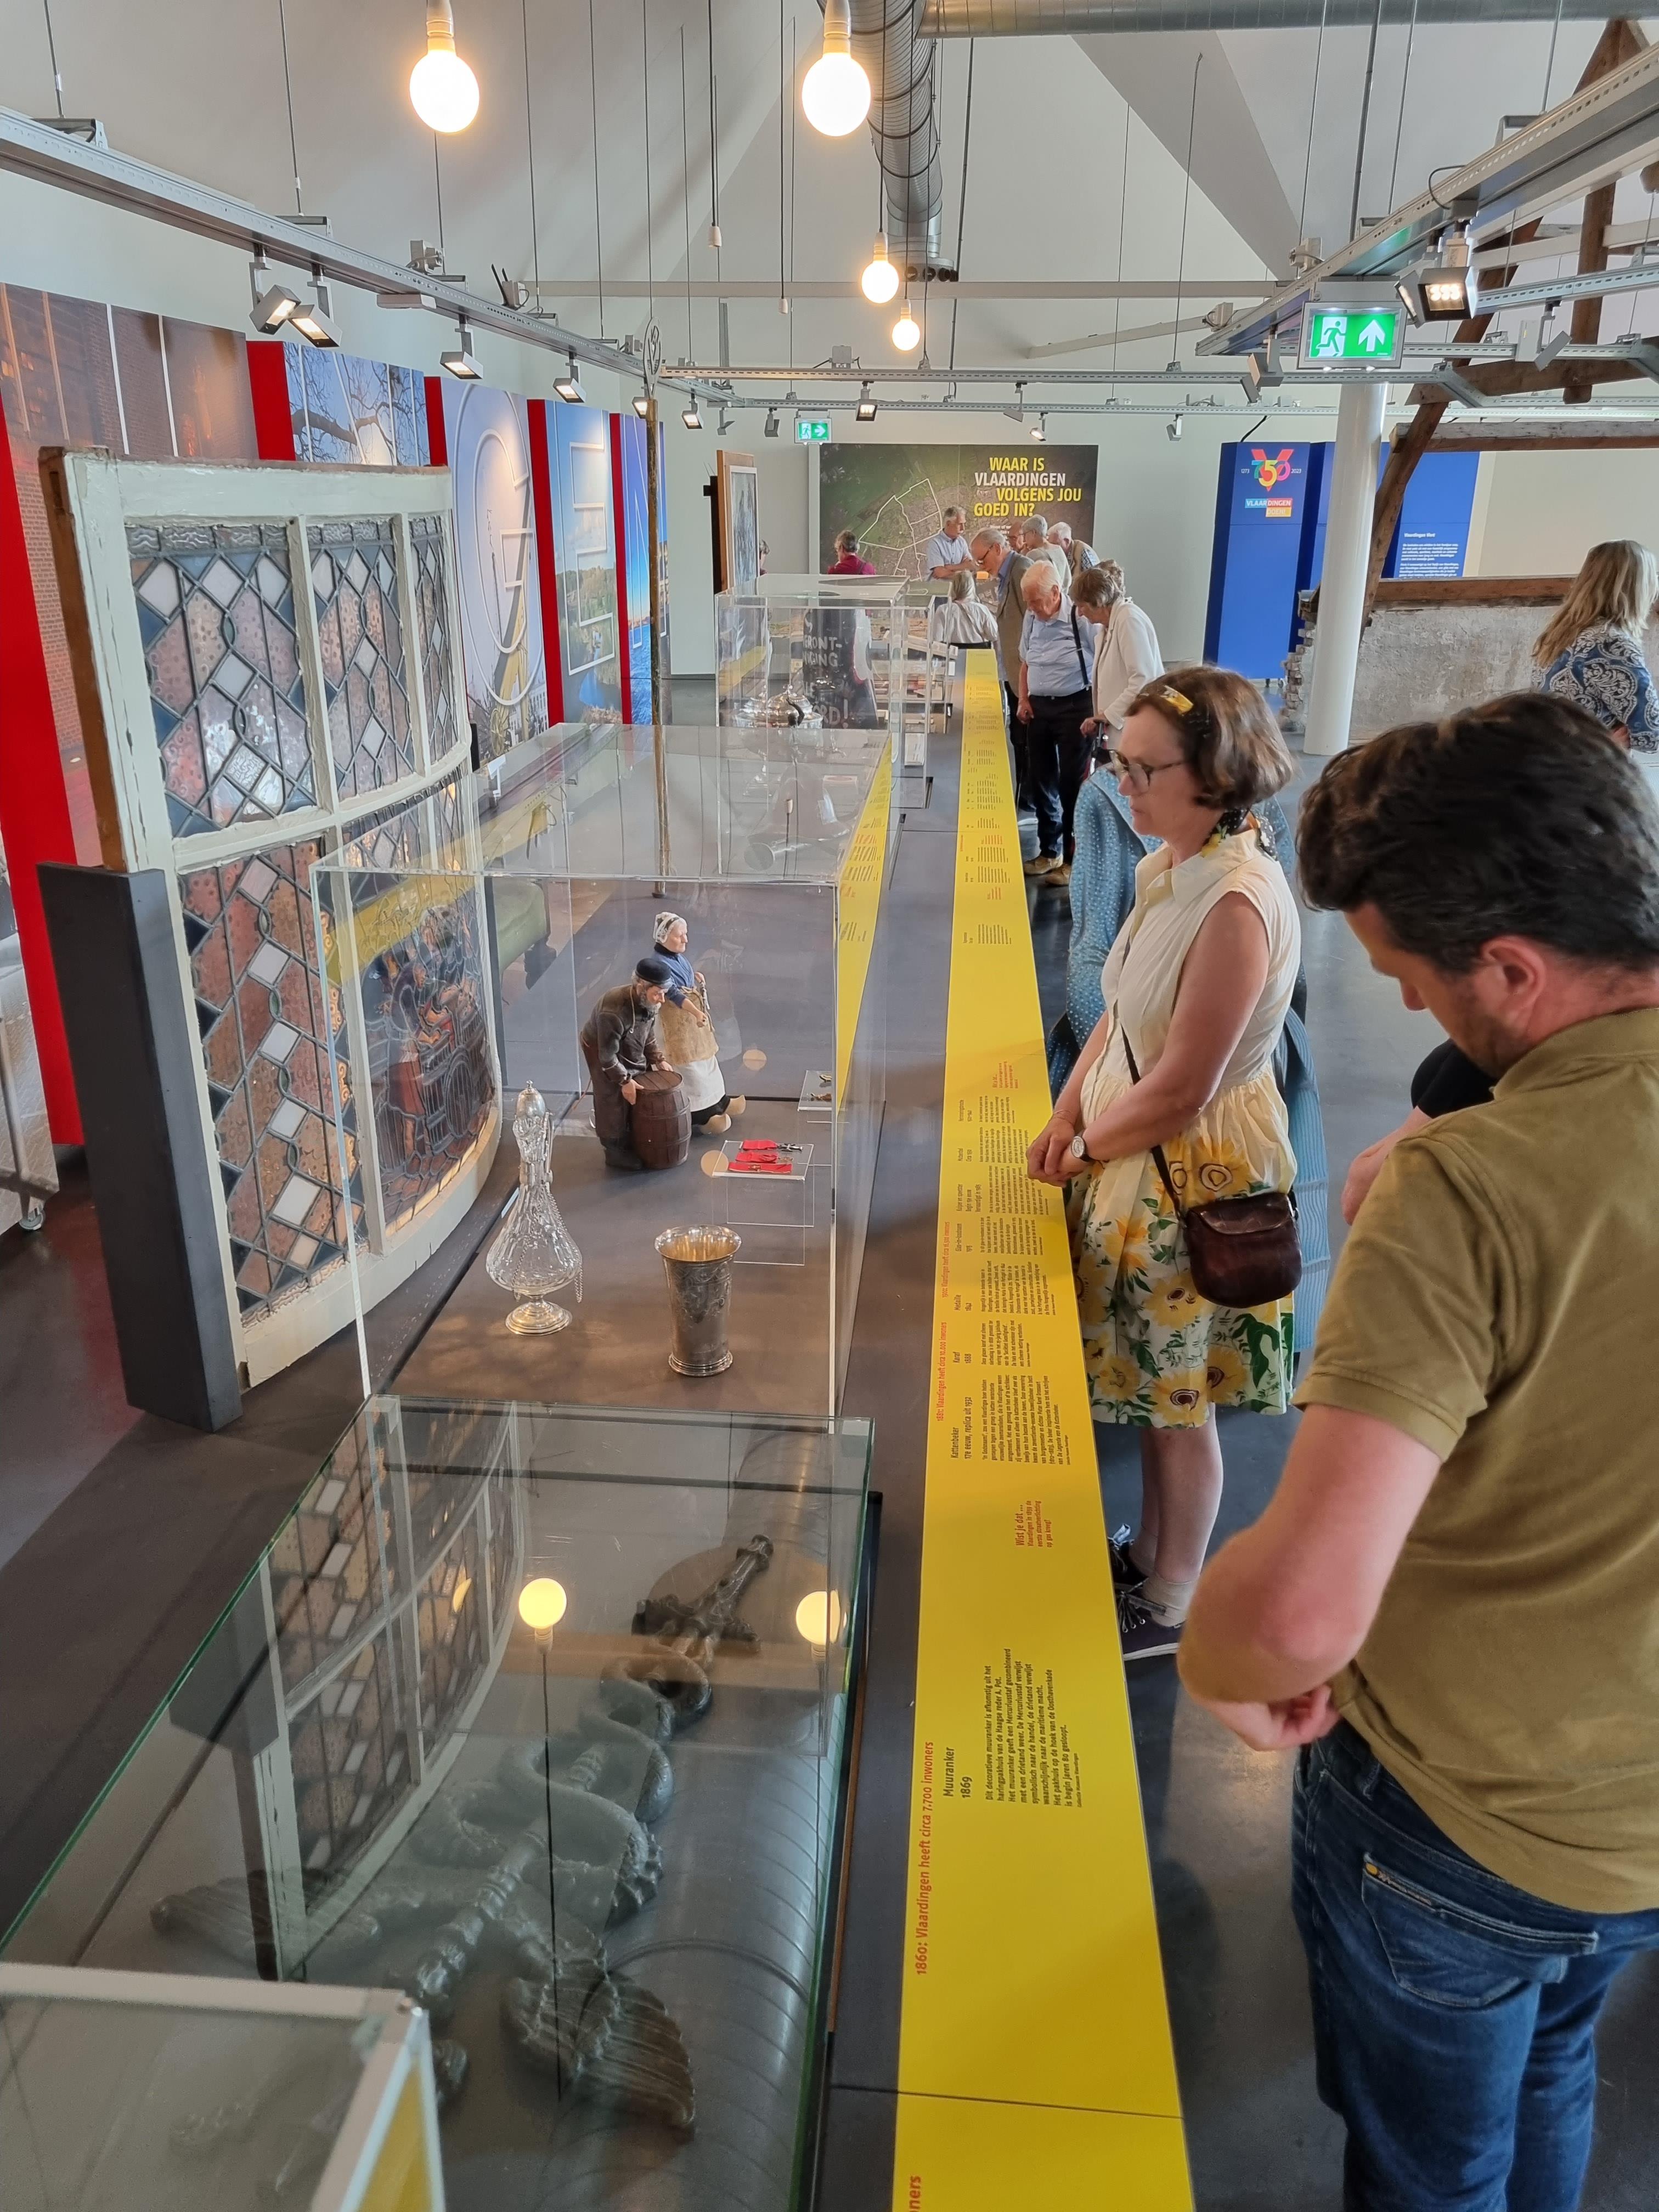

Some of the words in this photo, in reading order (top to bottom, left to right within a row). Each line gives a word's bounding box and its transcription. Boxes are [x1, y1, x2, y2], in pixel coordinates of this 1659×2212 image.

[989, 457, 1029, 471] WAAR
[1033, 458, 1045, 471] IS
[974, 472, 1066, 487] VLAARDINGEN
[996, 488, 1054, 501] VOLGENS
[1057, 488, 1082, 501] JOU
[974, 503, 1009, 517] GOED
[1014, 503, 1035, 517] IN?
[964, 1416, 973, 1432] replica
[951, 1427, 959, 1458] Kattenbeker
[1015, 1513, 1023, 1523] dat
[1015, 1532, 1024, 1545] Wist
[921, 1742, 933, 1784] inwoners
[943, 1747, 955, 1797] Muuranker
[961, 1776, 972, 1798] 1869
[923, 1787, 934, 1811] 7.700
[919, 1815, 931, 1837] circa
[918, 1839, 930, 1867] heeft
[916, 1871, 932, 1938] Vlaardingen
[915, 1942, 928, 1975] 1860:
[909, 2176, 921, 2212] ners
